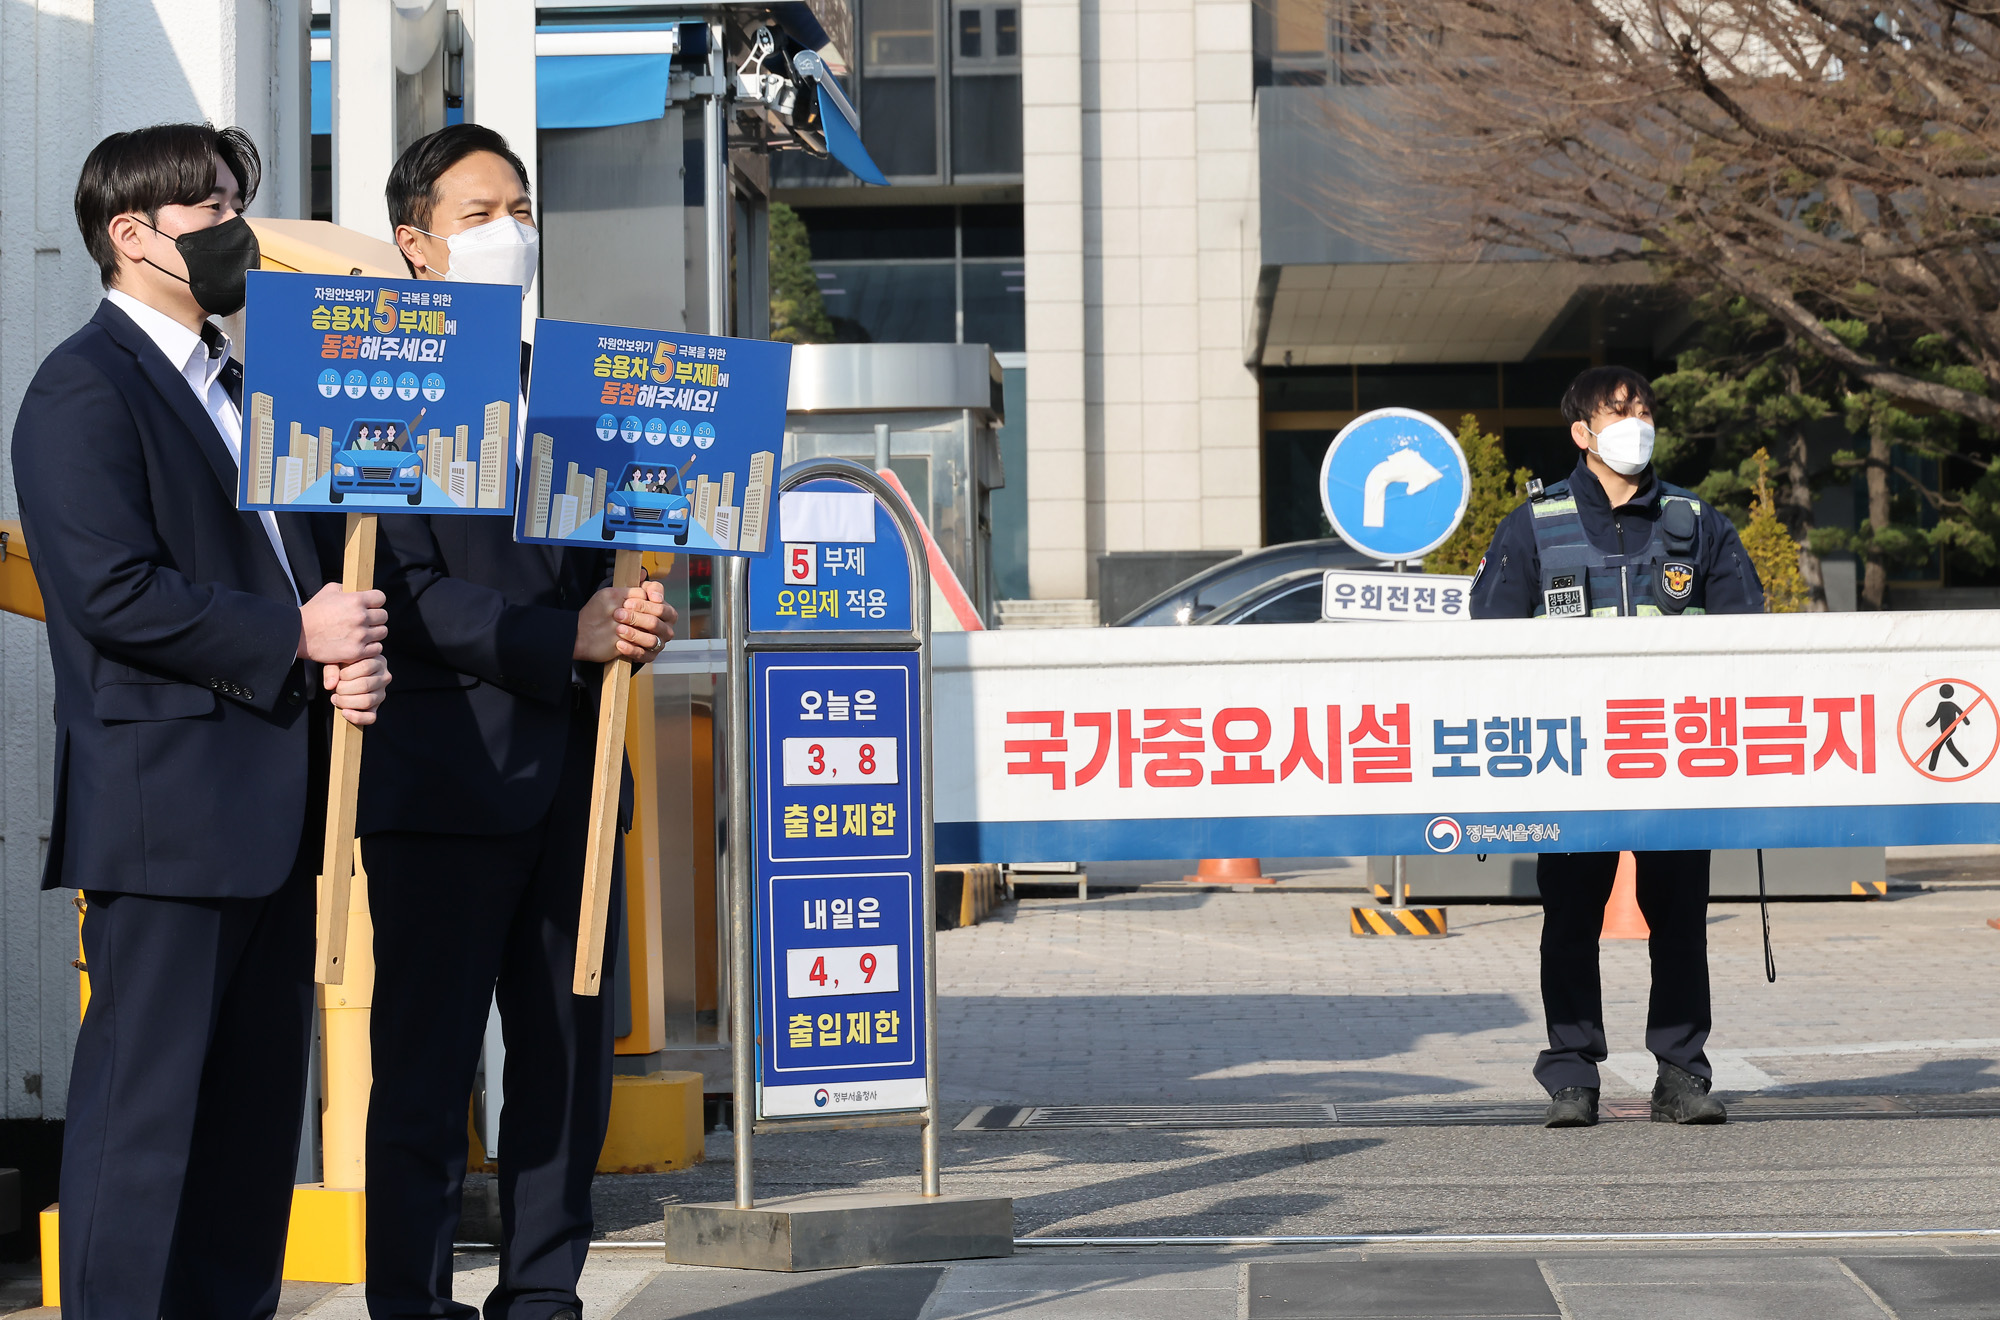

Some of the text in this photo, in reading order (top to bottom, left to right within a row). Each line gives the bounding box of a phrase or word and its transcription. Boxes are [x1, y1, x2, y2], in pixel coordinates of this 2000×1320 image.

[314, 288, 452, 306] 자원안보위기 극복을 위한
[312, 305, 371, 332] 승용차
[320, 334, 446, 362] 동참해주세요!
[598, 337, 726, 361] 자원안보위기 극복을 위한
[593, 354, 650, 381] 승용차
[325, 387, 437, 399] 월 화 수 목 금
[600, 381, 718, 413] 동참해주세요!
[603, 430, 707, 447] 월 화 수 목 금
[792, 547, 865, 579] 5 부제
[775, 588, 888, 619] 요일제 적용
[1334, 584, 1463, 615] 우회전전용
[1549, 590, 1579, 607] 정부청사
[1549, 604, 1581, 616] POLICE
[800, 689, 877, 721] 오늘은
[1004, 694, 1876, 790] 국가중요시설 보행자 통행금지
[858, 744, 876, 775] 8
[783, 803, 896, 838] 출입제한
[1465, 822, 1561, 843] 정부서울청사
[803, 897, 881, 930] 내일은
[859, 952, 877, 984] 9
[788, 1010, 900, 1048] 출입제한
[833, 1090, 878, 1103] 정부서울청사
